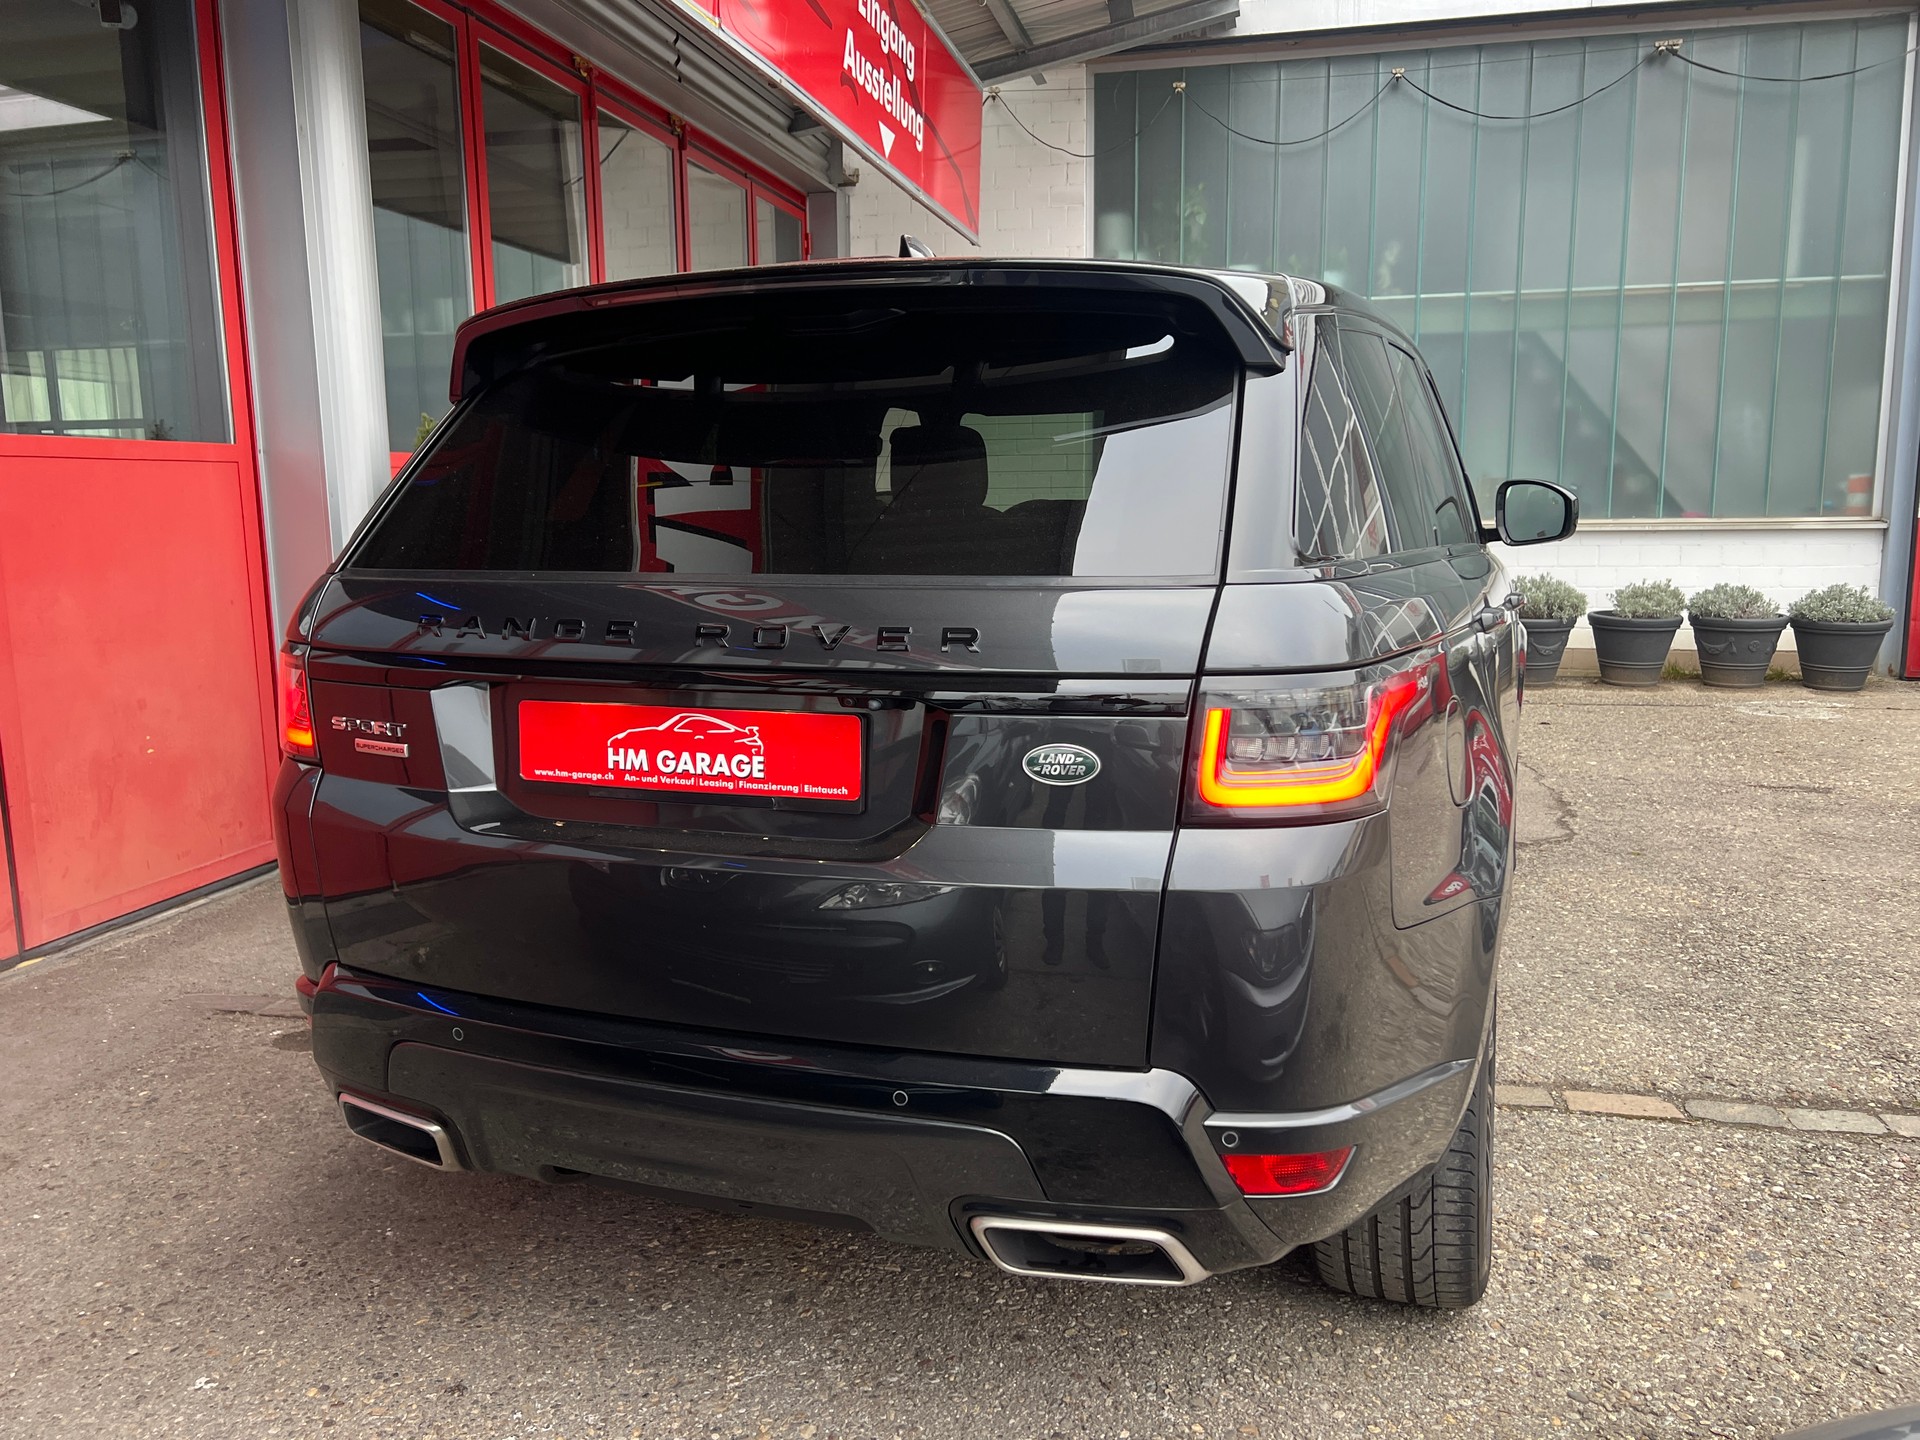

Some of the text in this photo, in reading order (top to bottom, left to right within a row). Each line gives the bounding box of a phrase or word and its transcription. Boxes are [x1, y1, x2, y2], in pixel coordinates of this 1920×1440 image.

[843, 28, 924, 152] Ausstellung
[417, 613, 981, 653] RANGE ROVER
[332, 716, 407, 737] SPORT
[356, 742, 405, 754] SUPERCHARGED
[1038, 753, 1075, 764] LAND
[607, 748, 766, 779] HM GARAGE
[1041, 764, 1086, 776] ROVER
[534, 769, 614, 781] www.hm-garage.ch
[624, 773, 848, 795] An- und Verkauf Leasing Finanzierung Eintausch
